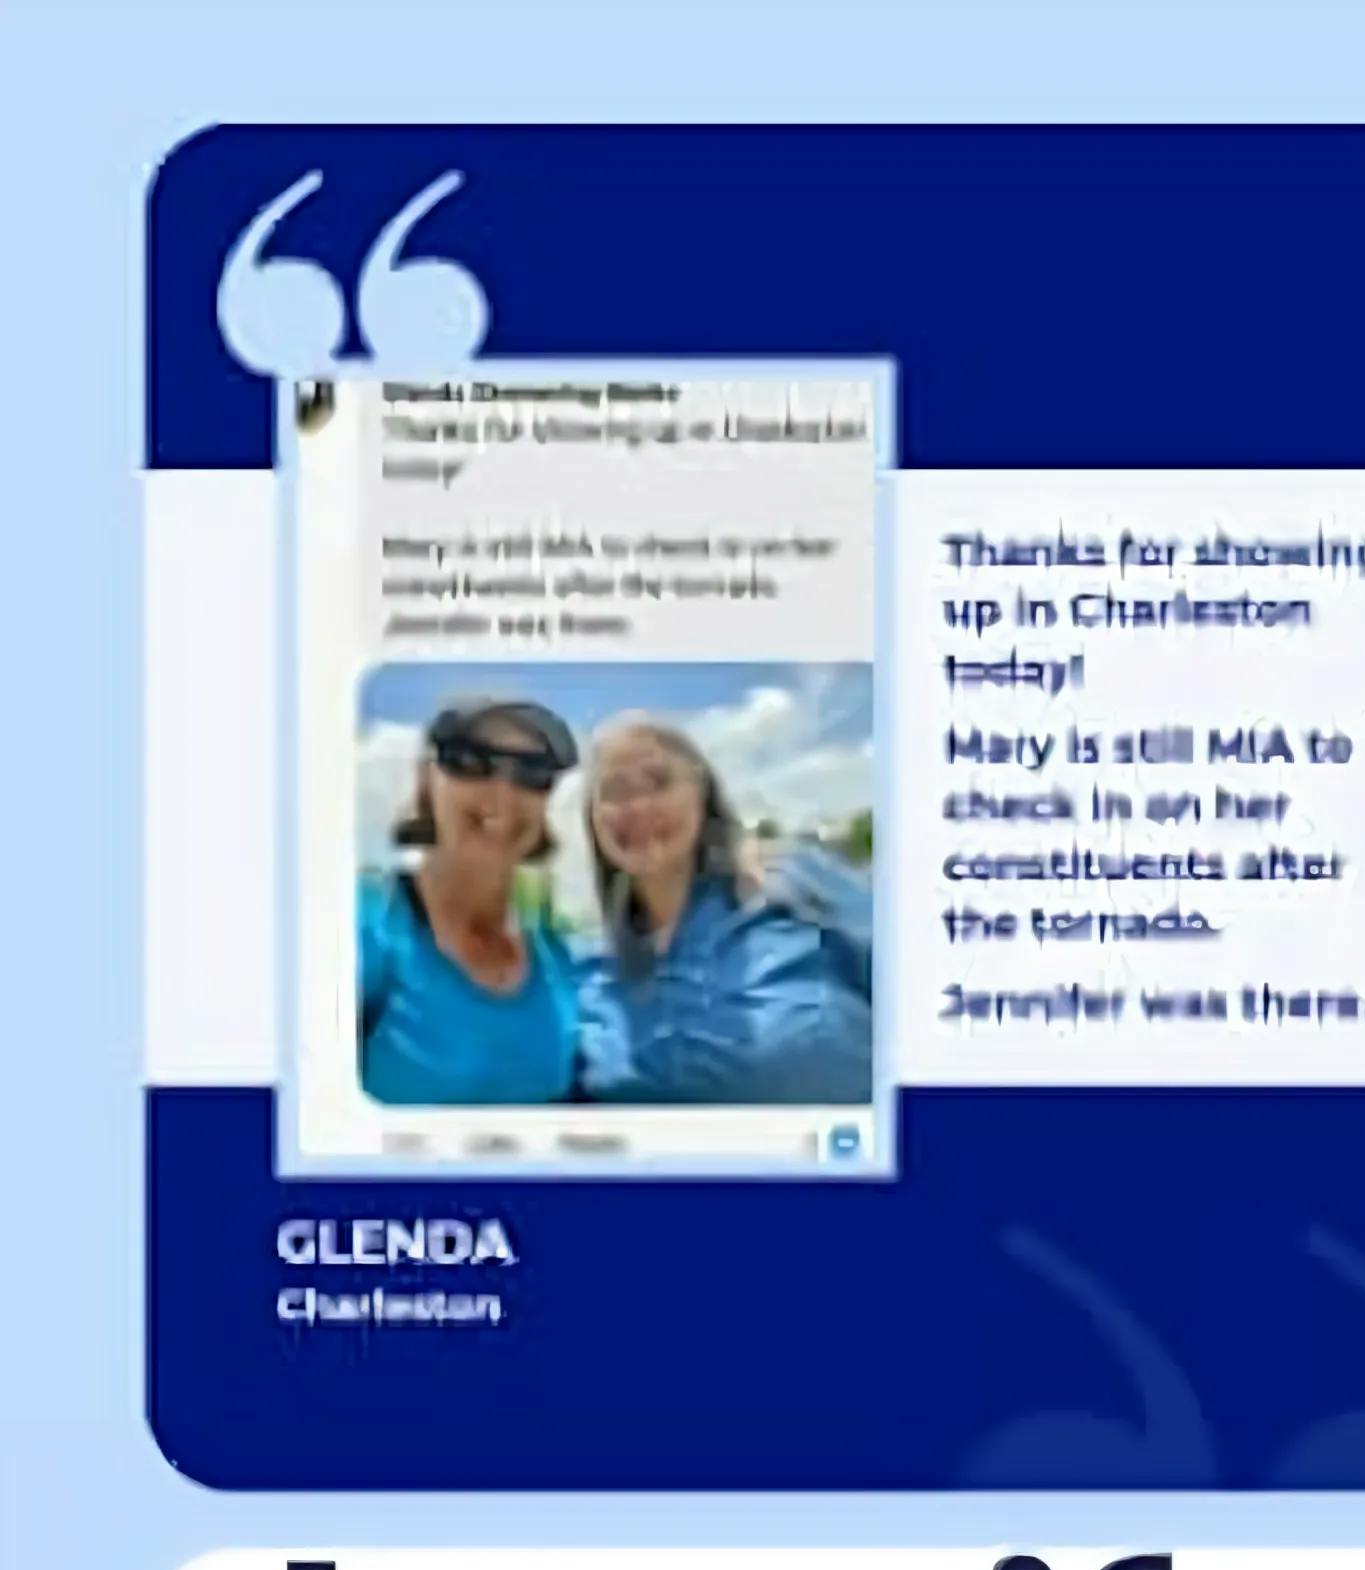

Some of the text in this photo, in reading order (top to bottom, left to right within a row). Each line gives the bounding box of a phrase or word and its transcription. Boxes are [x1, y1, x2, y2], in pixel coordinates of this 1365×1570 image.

[1119, 531, 1178, 571] for
[943, 600, 1002, 638] up
[1016, 589, 1057, 627] in
[946, 725, 1054, 771] Mary
[1068, 727, 1099, 763] is
[1208, 728, 1294, 763] MIA
[1306, 730, 1352, 764] to
[1092, 786, 1132, 821] in
[942, 907, 1017, 944] the
[278, 1220, 515, 1264] GLENDA
